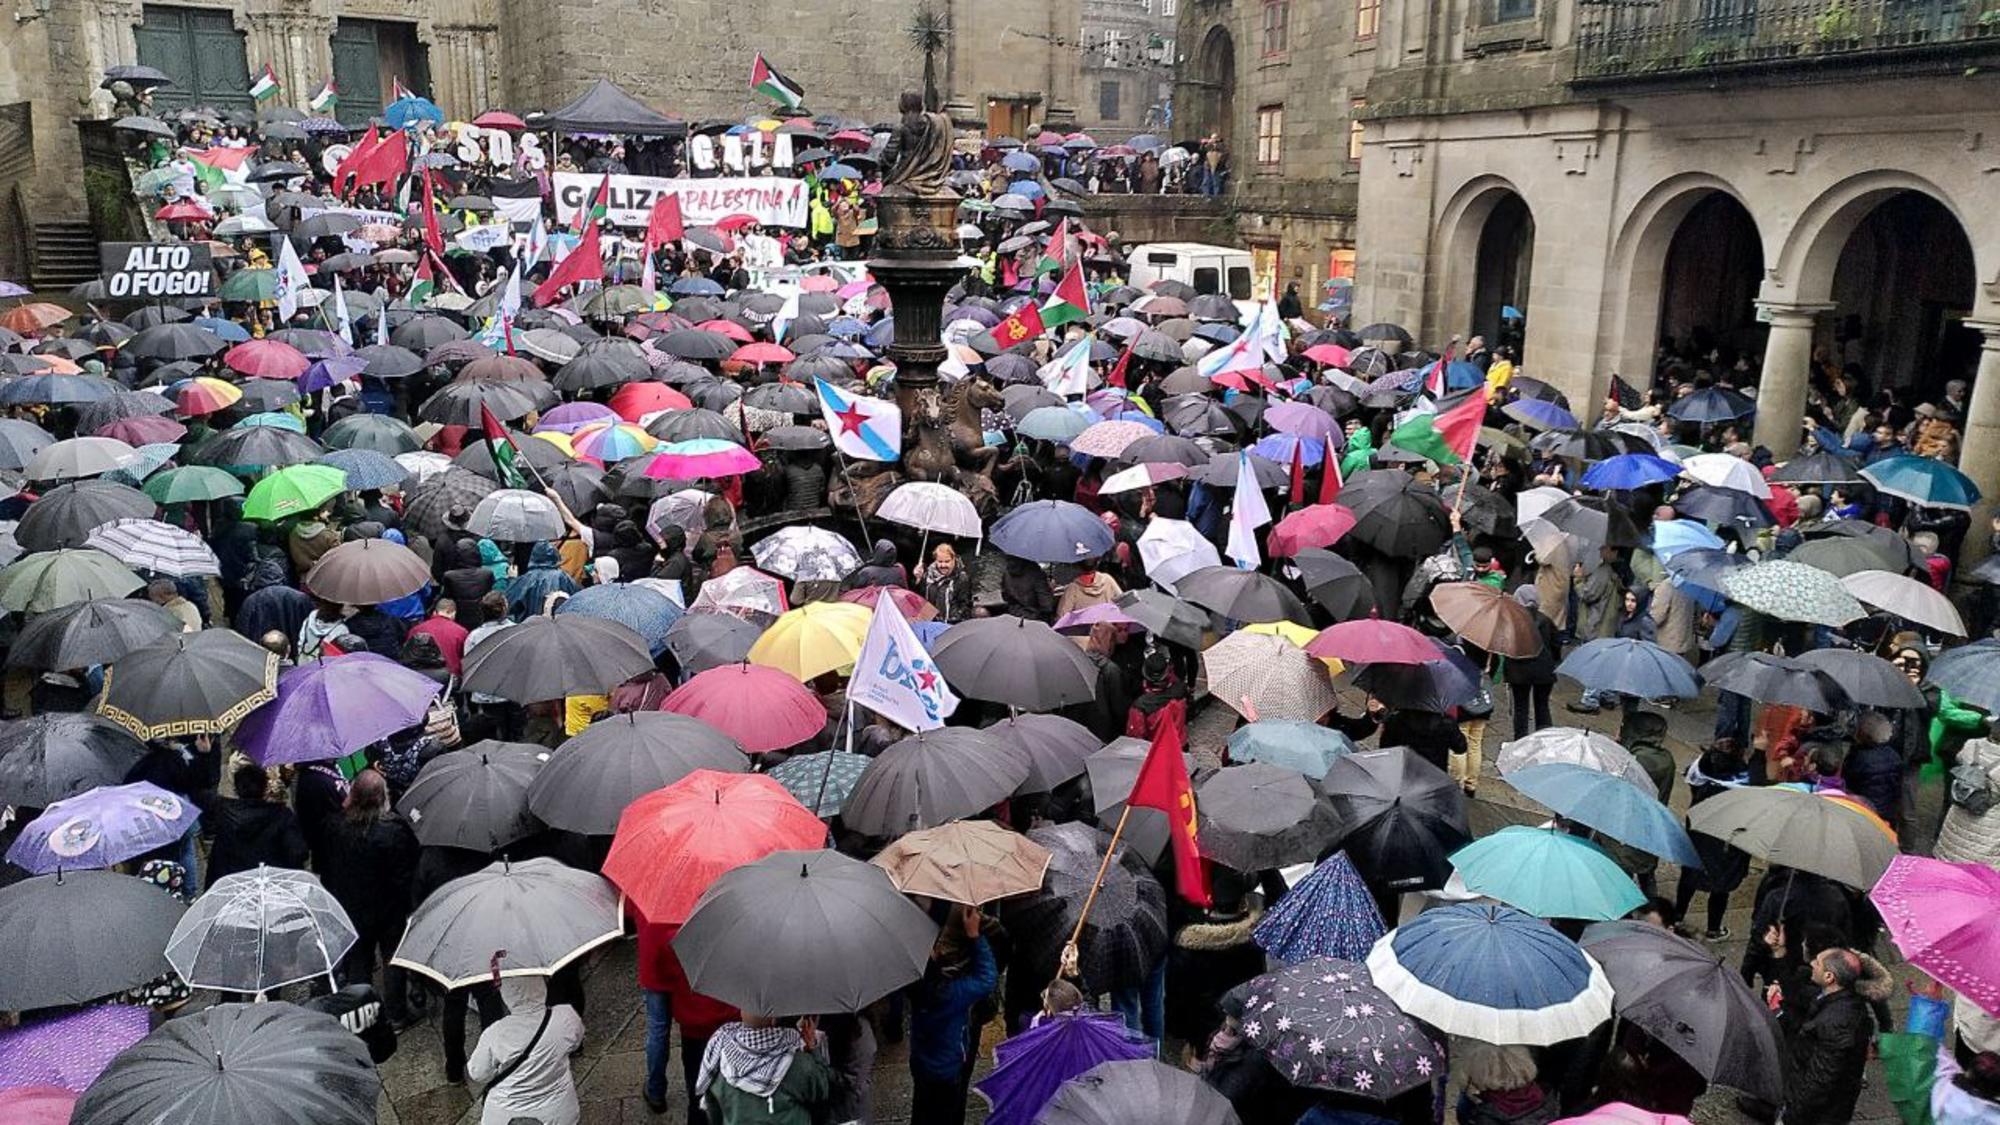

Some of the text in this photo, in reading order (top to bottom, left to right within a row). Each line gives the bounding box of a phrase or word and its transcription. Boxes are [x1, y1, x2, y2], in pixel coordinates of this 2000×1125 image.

[456, 123, 794, 171] SOS GAZA
[685, 187, 784, 211] PALESTINA
[124, 246, 190, 271] ALTO
[109, 271, 210, 296] O FOGO!
